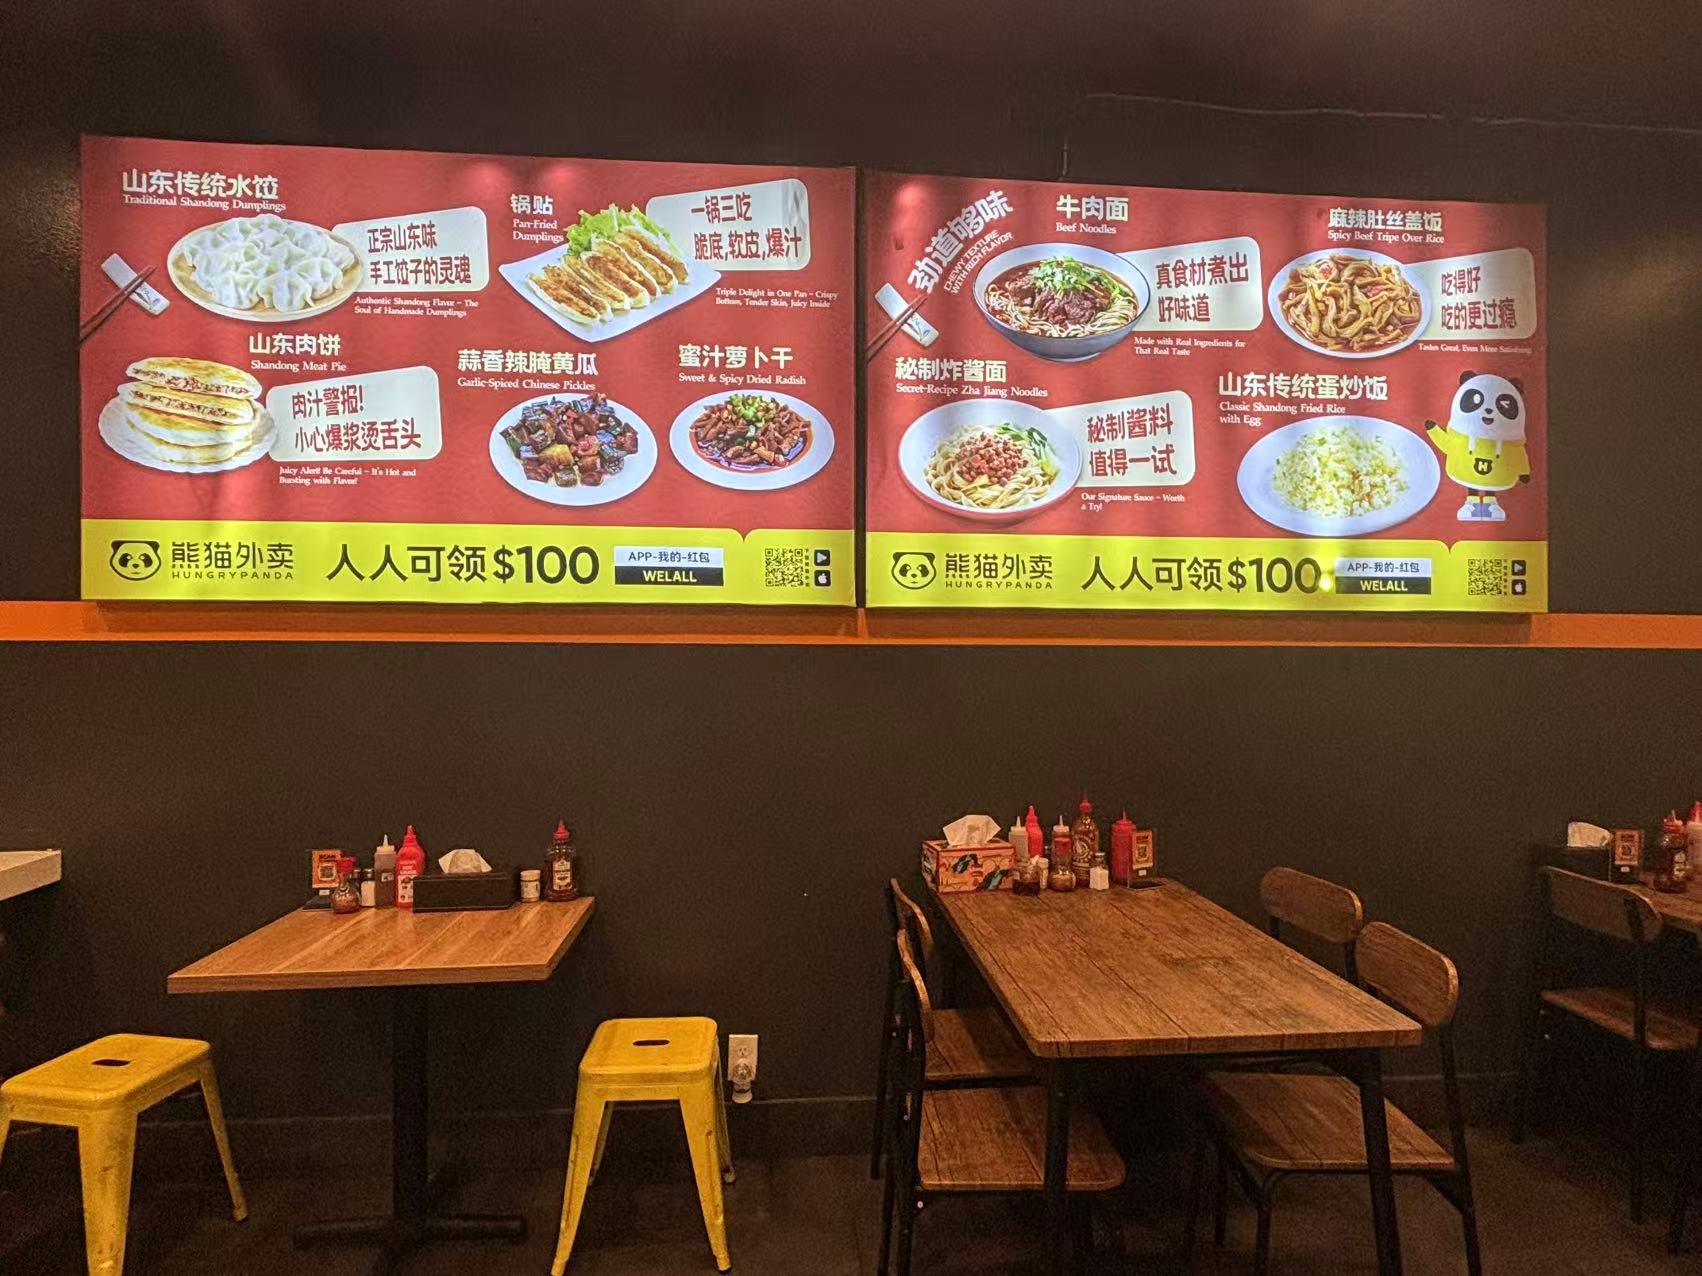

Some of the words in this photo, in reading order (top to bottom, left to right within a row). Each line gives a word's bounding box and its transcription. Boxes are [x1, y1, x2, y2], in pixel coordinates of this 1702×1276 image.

[122, 168, 278, 199] 山东传统水饺
[123, 194, 176, 206] Traditional
[180, 198, 228, 210] Shandong
[232, 200, 286, 212] Dumplings
[511, 194, 553, 215] 锅贴
[691, 192, 752, 224] 一锅三吃
[1056, 194, 1128, 222] 牛肉面
[513, 219, 557, 230] Pan-Fried
[1328, 207, 1442, 232] 麻辣肚丝盖饭
[1056, 222, 1076, 232] Beef
[1080, 223, 1116, 234] Noodles
[368, 220, 437, 253] 正宗山东味
[513, 231, 564, 243] Dumplings
[907, 190, 1014, 294] 劲道够味
[1328, 230, 1351, 242] Spicy
[1354, 231, 1373, 240] Beef
[1376, 232, 1400, 243] Tripe
[1402, 233, 1423, 242] Over
[1426, 234, 1444, 243] Rice
[944, 256, 966, 291] CHEWY
[964, 230, 1000, 260] TEXTURE
[951, 270, 969, 294] WITH
[981, 232, 1014, 256] FLAVOR
[370, 254, 472, 285] 手工饺子的灵魂
[1156, 252, 1248, 289] 真食材煮出
[1442, 266, 1480, 296] 吃得好
[354, 296, 391, 305] Authentic
[394, 298, 430, 307] Shandong
[716, 288, 736, 297] Triple
[739, 288, 764, 298] Delight
[777, 290, 792, 298] One
[816, 291, 838, 300] Crispy
[746, 298, 768, 306] Tender
[770, 299, 788, 308] Skin,
[790, 300, 807, 308] Juicy
[810, 300, 830, 308] Inside
[1158, 293, 1210, 322] 好味道
[354, 306, 371, 314] Soul
[374, 306, 382, 314] of
[384, 307, 424, 316] Handmade
[426, 308, 468, 318] Dumplings
[1442, 297, 1516, 330] 吃的更过瘾
[250, 332, 340, 356] 山东肉饼
[1176, 338, 1191, 346] Real
[1194, 339, 1232, 348] Ingredients
[1235, 340, 1246, 348] for
[1462, 344, 1478, 352] Even
[1480, 344, 1498, 352] More
[678, 344, 794, 369] 蜜汁萝卜干
[1172, 348, 1190, 356] Taste
[250, 360, 300, 372] Shandong
[303, 361, 327, 372] Meat
[331, 362, 347, 372] Pie
[458, 349, 598, 376] 蒜香辣腌黄瓜
[896, 356, 1006, 382] 秘制炸酱面
[458, 378, 519, 390] Garlic-Spiced
[523, 379, 560, 390] Chinese
[564, 380, 596, 390] Pickles
[678, 372, 705, 382] Sweet
[708, 374, 716, 382] &
[720, 374, 744, 386] Spicy
[746, 374, 772, 384] Dried
[776, 376, 806, 385] Radish
[1218, 371, 1388, 400] 山东传统蛋炒饭
[896, 383, 958, 395] Secret-Recipe
[961, 384, 980, 394] Zha
[984, 386, 1008, 398] Jiang
[1011, 386, 1048, 397] Noodles
[1220, 402, 1250, 412] Classic
[1253, 402, 1298, 414] Shandong
[1300, 404, 1323, 413] Fried
[1326, 404, 1346, 414] Rice
[1087, 402, 1174, 444] 秘制酱料
[1220, 414, 1240, 424] with
[1244, 415, 1262, 426] Egg
[295, 417, 422, 453] 小心爆浆烫舌头
[1089, 444, 1177, 477] 值得一试
[1478, 461, 1488, 472] H
[279, 466, 298, 476] Juicy
[322, 467, 332, 475] Be
[334, 467, 362, 476] Careful
[386, 468, 400, 476] Hot
[402, 468, 416, 476] and
[279, 476, 310, 486] Bursting
[313, 476, 332, 484] with
[1081, 492, 1096, 500] Our
[1098, 493, 1132, 502] Signature
[1162, 494, 1185, 502] Worth
[172, 542, 294, 569] 熊猫外卖
[628, 550, 710, 564] APP-我的-红包
[326, 544, 600, 584] 人人可领$100
[945, 553, 1053, 580] 熊猫外卖
[1347, 562, 1420, 573] APP-我的-红包
[172, 571, 294, 580] HUNGRYPANDA
[643, 570, 698, 583] WELALL
[1081, 556, 1322, 594] 人人可领$100
[945, 580, 1053, 590] HUNGRYPANDA
[1360, 580, 1408, 592] WELALL
